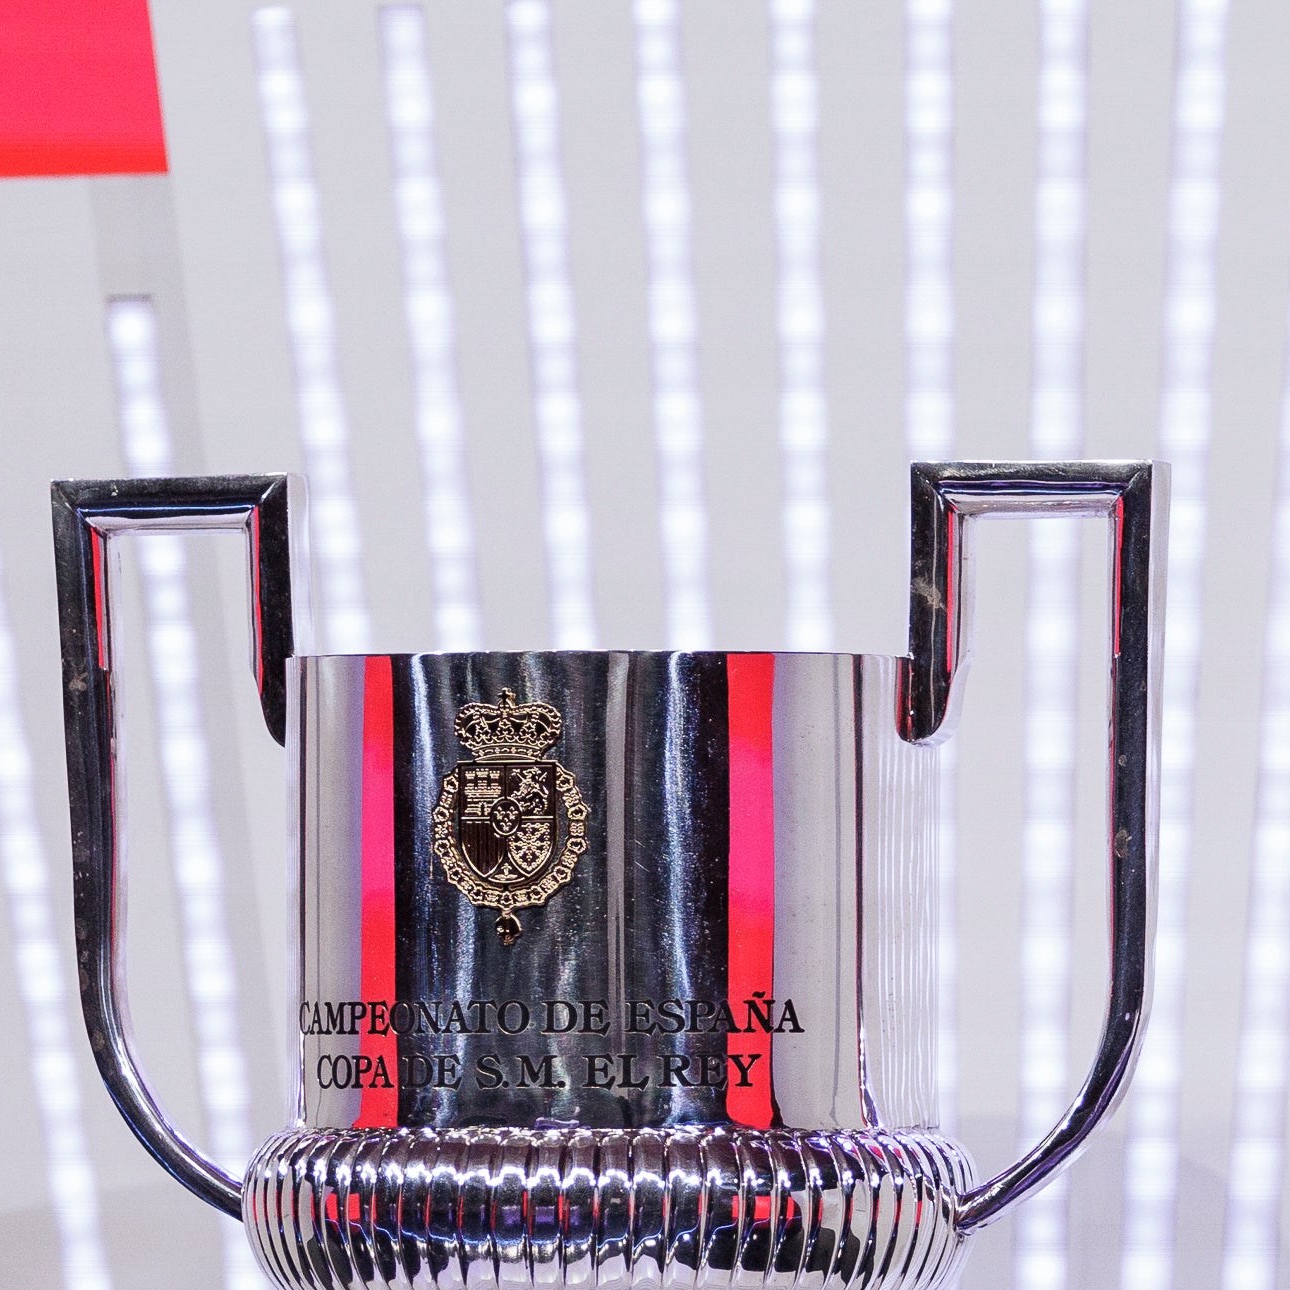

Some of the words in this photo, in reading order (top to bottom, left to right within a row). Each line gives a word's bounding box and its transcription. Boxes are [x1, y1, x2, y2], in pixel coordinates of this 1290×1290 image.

[299, 1000, 531, 1036] CAMPEONATO
[541, 999, 611, 1036] DE
[624, 991, 806, 1036] ESPAÑA
[317, 1053, 395, 1090] COPA
[401, 1053, 463, 1090] DE
[475, 1053, 567, 1090] S.M.
[582, 1053, 651, 1091] EL
[656, 1053, 763, 1091] REY
